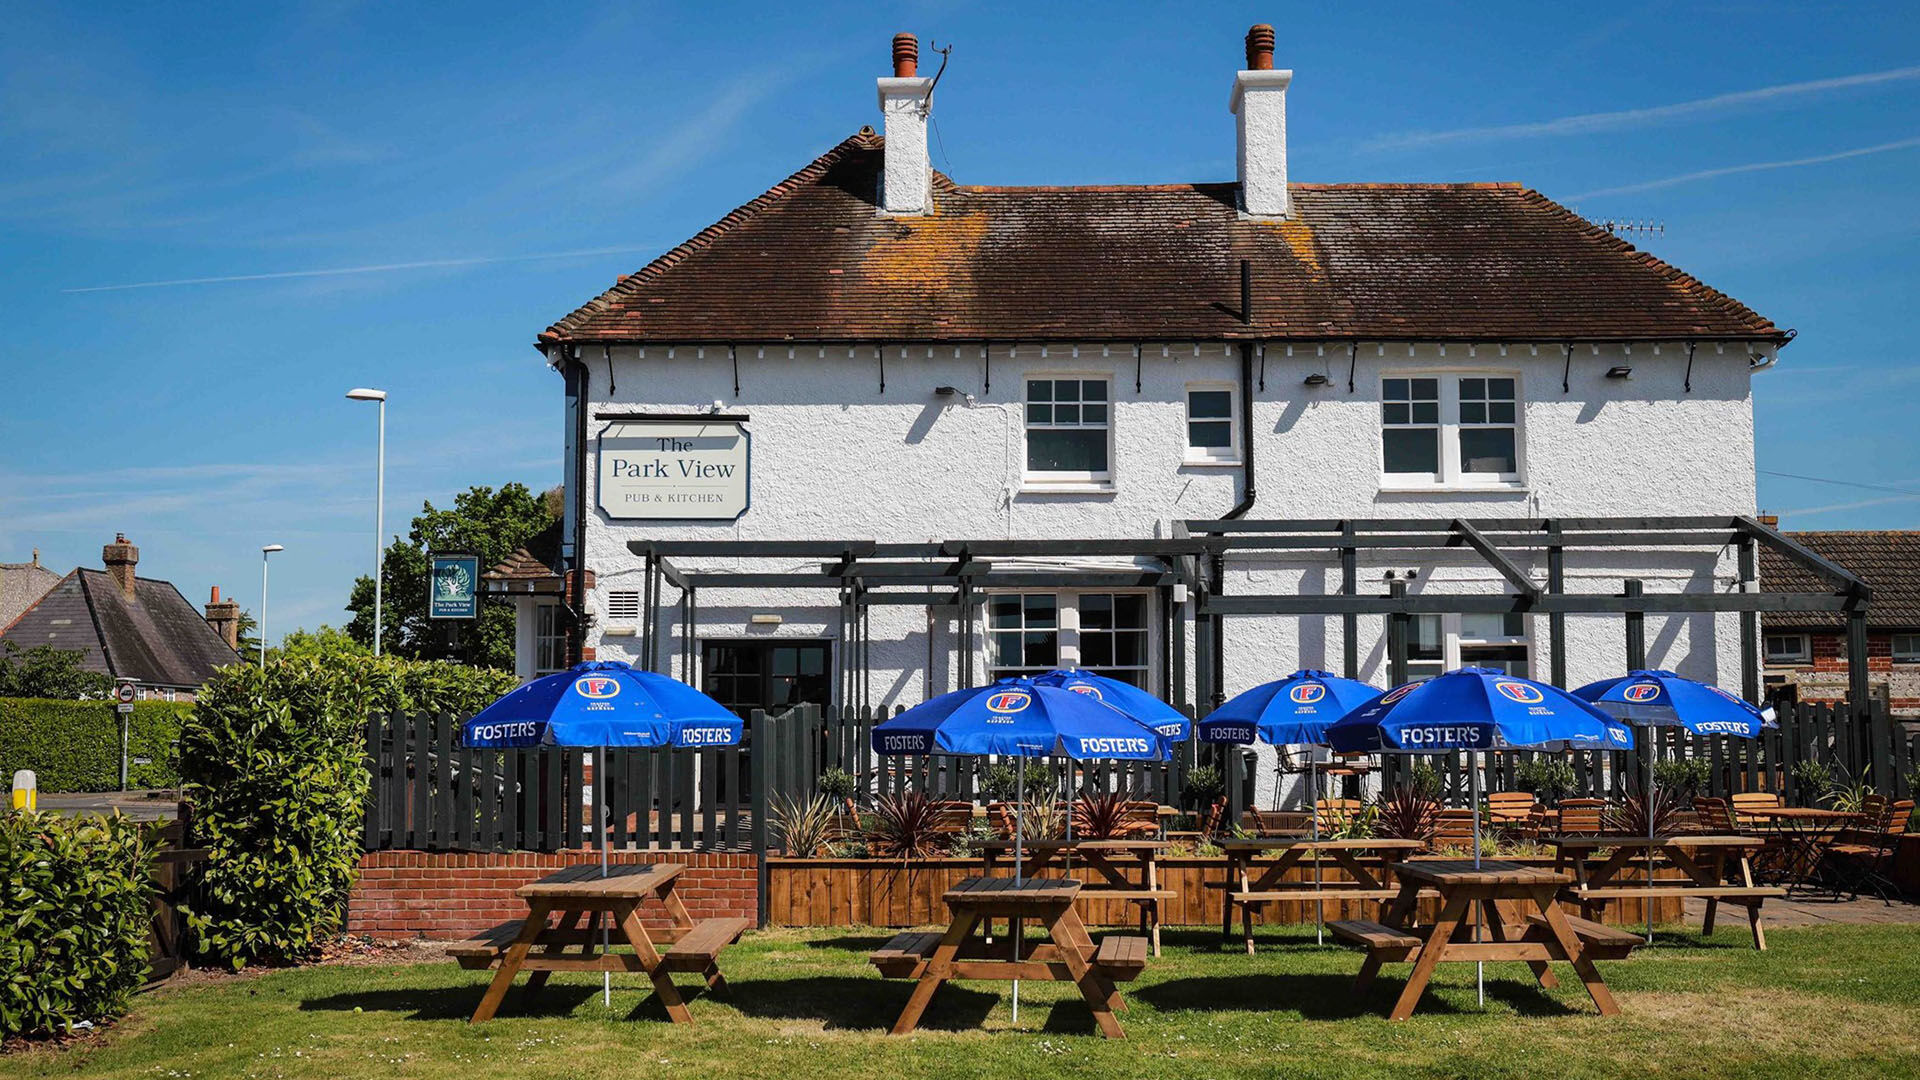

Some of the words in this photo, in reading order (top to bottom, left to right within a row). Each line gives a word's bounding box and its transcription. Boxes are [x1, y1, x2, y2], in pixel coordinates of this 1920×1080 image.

[656, 437, 693, 452] The
[612, 459, 669, 478] Park
[677, 459, 736, 478] View
[625, 493, 650, 503] PUB
[654, 493, 663, 503] &
[668, 493, 724, 503] KITCHEN
[588, 680, 608, 695] F
[1300, 687, 1317, 700] F
[1504, 683, 1529, 699] F
[1633, 687, 1652, 699] F
[996, 695, 1022, 709] F
[473, 721, 537, 740] FOSTER'S
[1209, 727, 1250, 741] FOSTER'S
[1695, 721, 1750, 734] FOSTER'S
[682, 727, 732, 744] FOSTER'S
[884, 733, 925, 751] FOSTER'S
[1401, 727, 1480, 744] FOSTER'S
[1080, 738, 1149, 753] FOSTER'S
